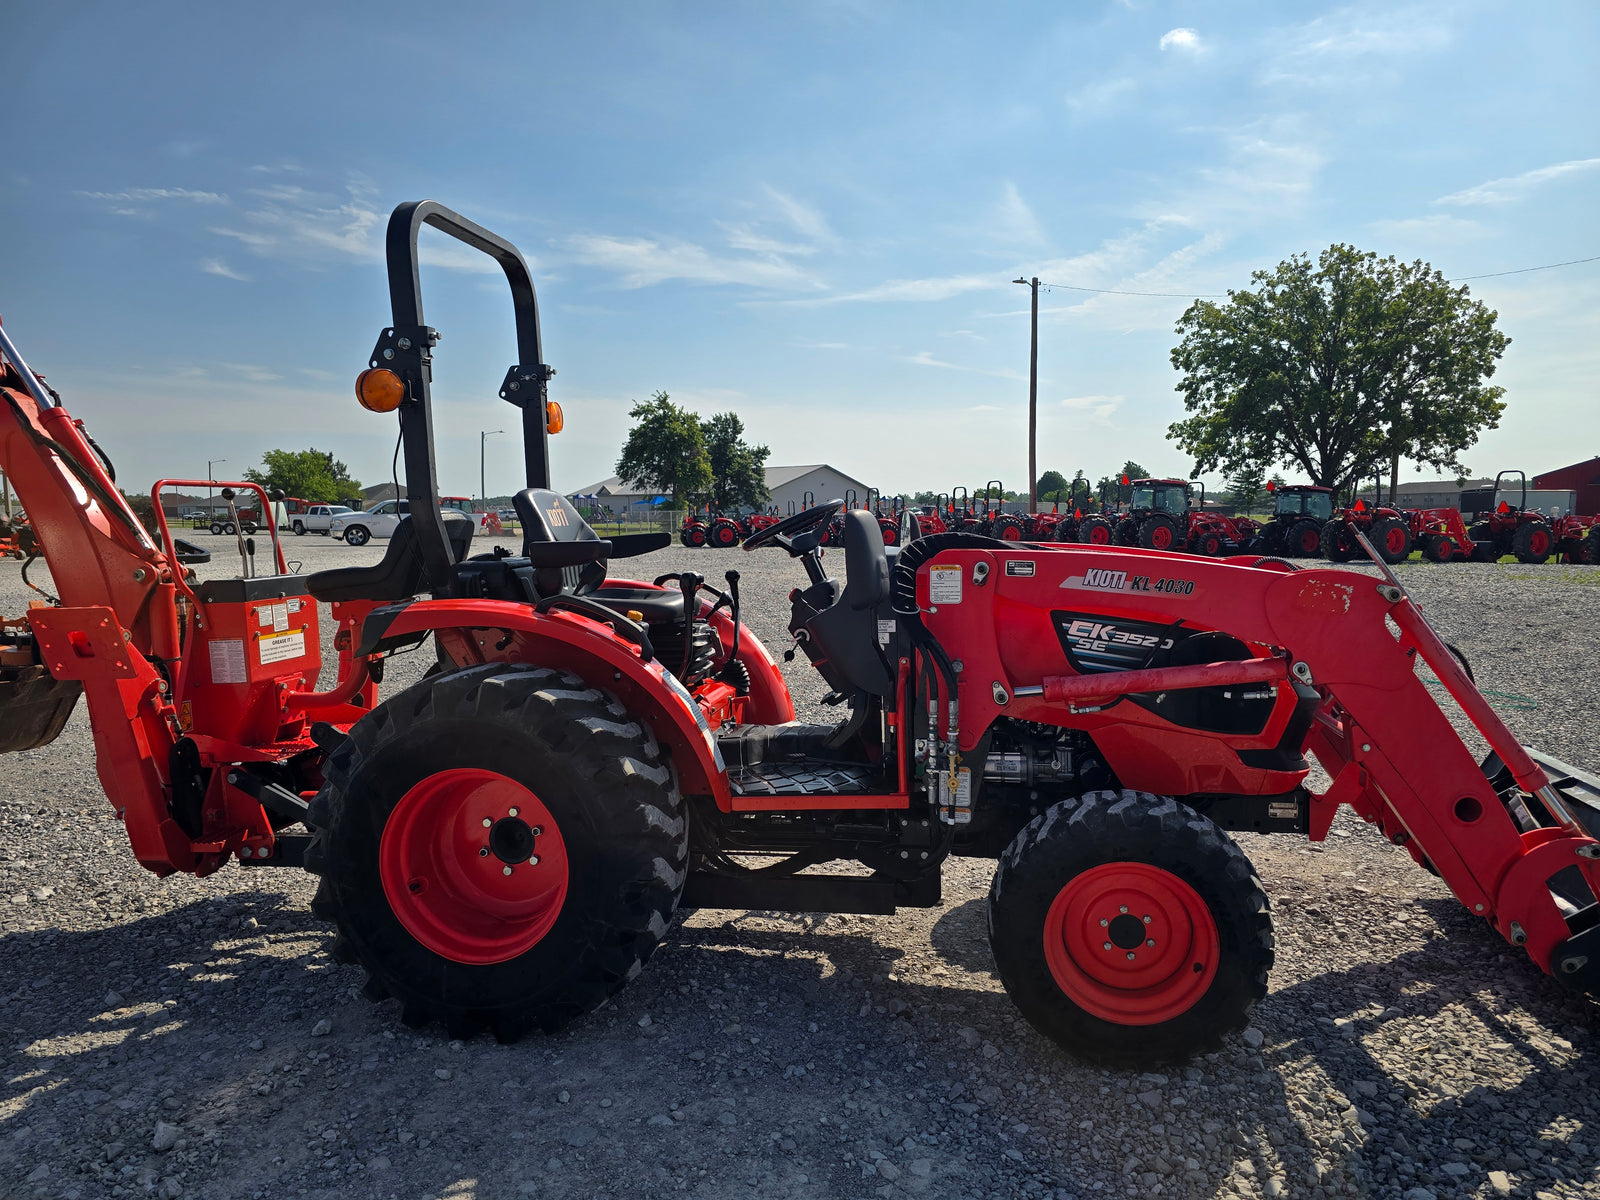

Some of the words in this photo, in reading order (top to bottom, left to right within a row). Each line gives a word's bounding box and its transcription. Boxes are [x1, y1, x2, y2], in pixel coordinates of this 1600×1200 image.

[1082, 568, 1127, 589] KIOTI
[1131, 576, 1151, 592] KL
[1154, 578, 1195, 595] 4030
[272, 638, 287, 646] GREASE
[1075, 638, 1109, 652] SE
